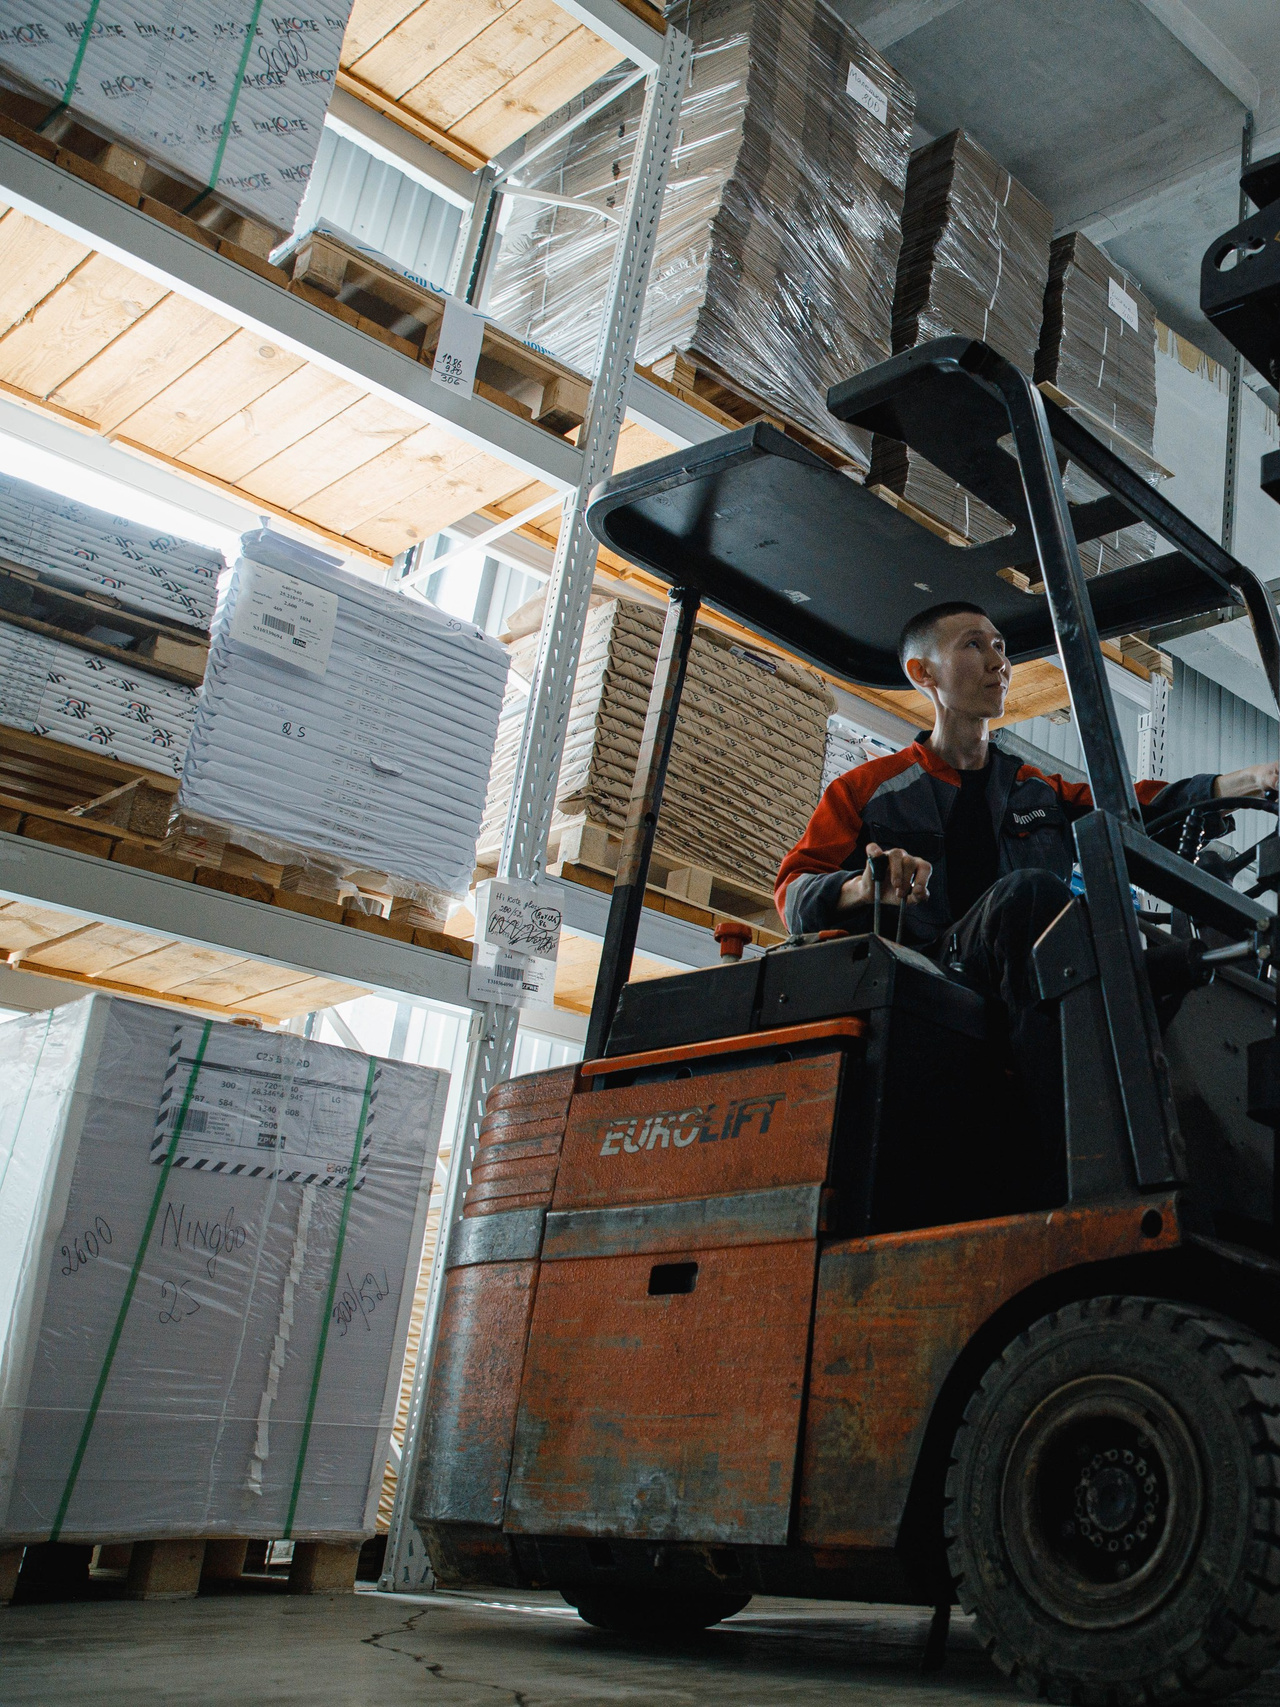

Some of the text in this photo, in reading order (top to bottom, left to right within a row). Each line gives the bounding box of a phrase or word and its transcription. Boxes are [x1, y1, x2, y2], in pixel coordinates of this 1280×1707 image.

[221, 1080, 237, 1090] 300
[258, 1120, 279, 1131] 2600
[599, 1091, 787, 1157] EUROLIFT
